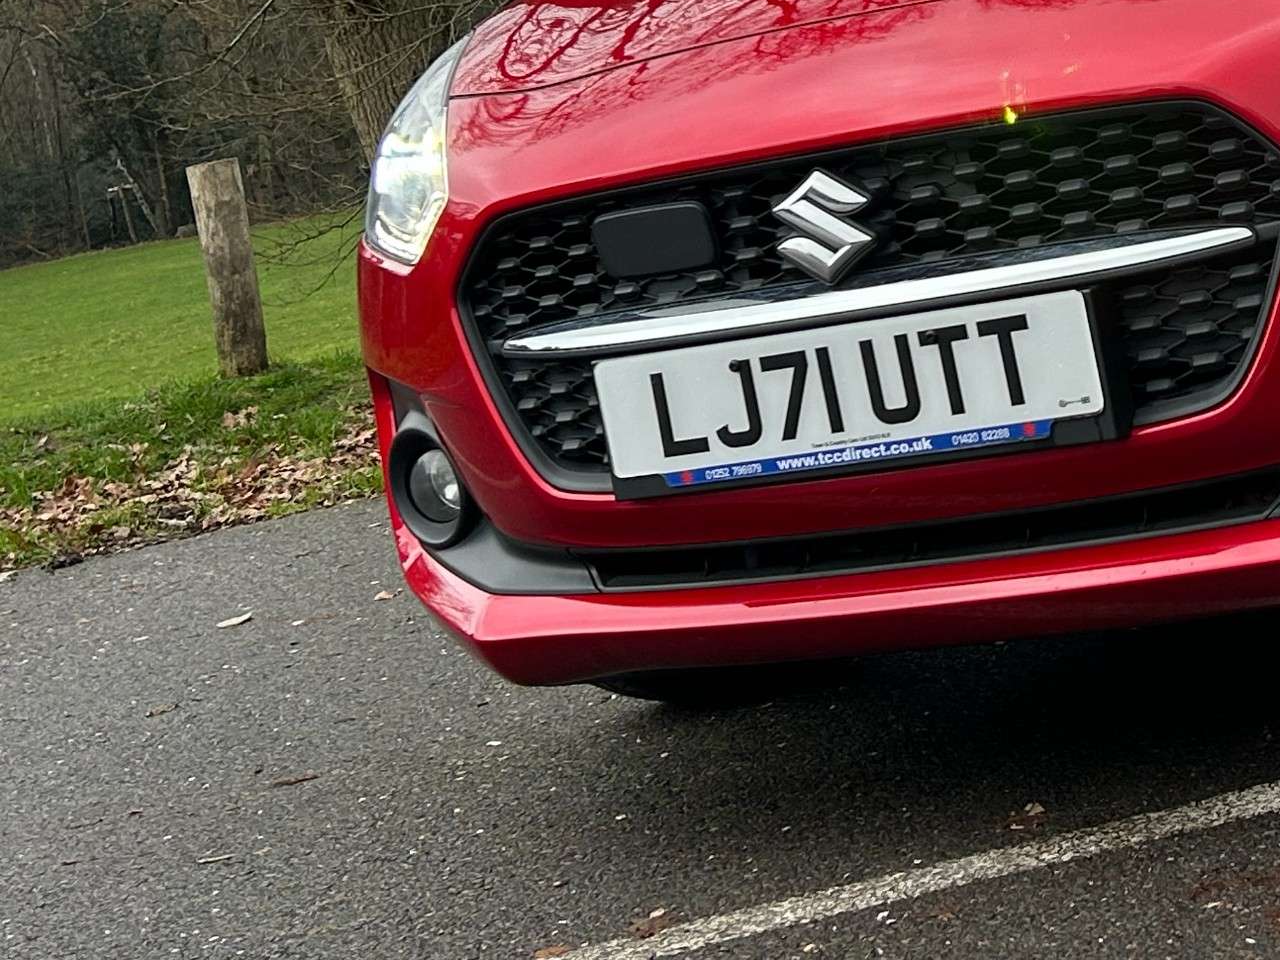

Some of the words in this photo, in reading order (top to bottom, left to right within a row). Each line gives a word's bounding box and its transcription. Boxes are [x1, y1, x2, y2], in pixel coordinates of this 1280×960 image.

[650, 346, 845, 458] LJ71
[859, 313, 1030, 426] UTT
[776, 436, 933, 470] www.tccdirect.co.uk
